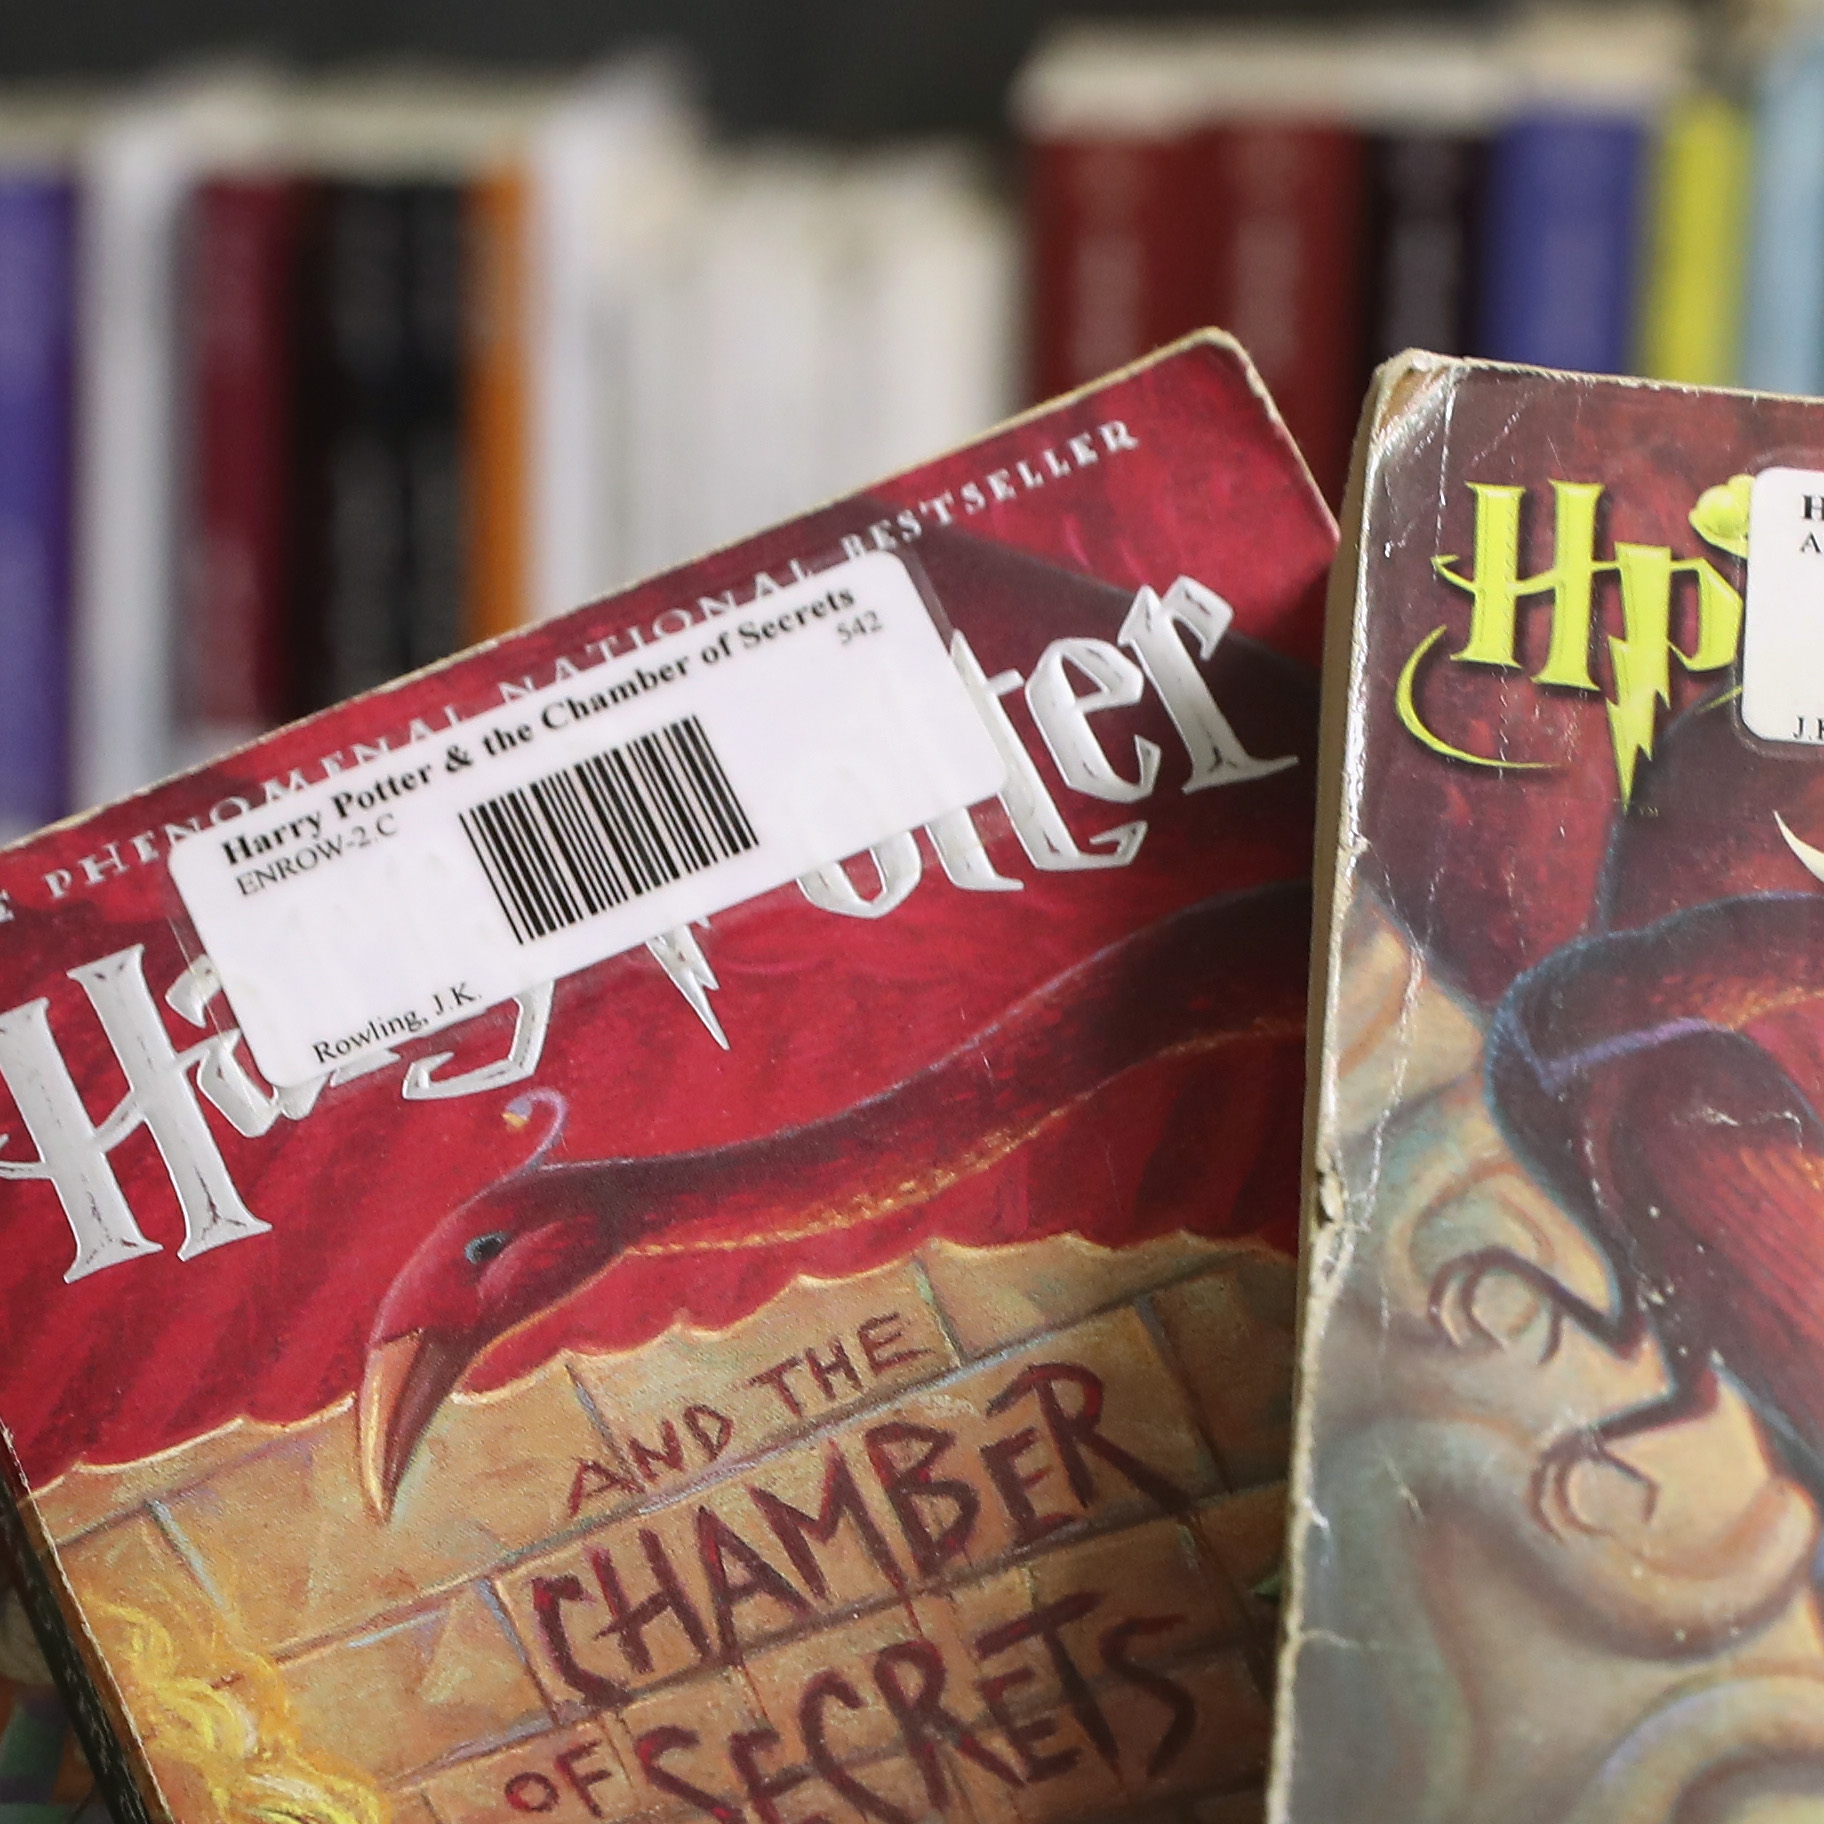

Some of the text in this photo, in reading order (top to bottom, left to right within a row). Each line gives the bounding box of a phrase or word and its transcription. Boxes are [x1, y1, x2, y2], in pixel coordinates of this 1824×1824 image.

[840, 419, 1140, 561] BESTSELLER
[837, 608, 885, 646] 542
[220, 583, 857, 866] Harry Potter & the Chamber of Secrets
[311, 980, 484, 1064] Rowling, J.K.
[566, 1311, 936, 1518] AND THE
[532, 1363, 1194, 1700] CHAMBER
[503, 1740, 612, 1818] OF
